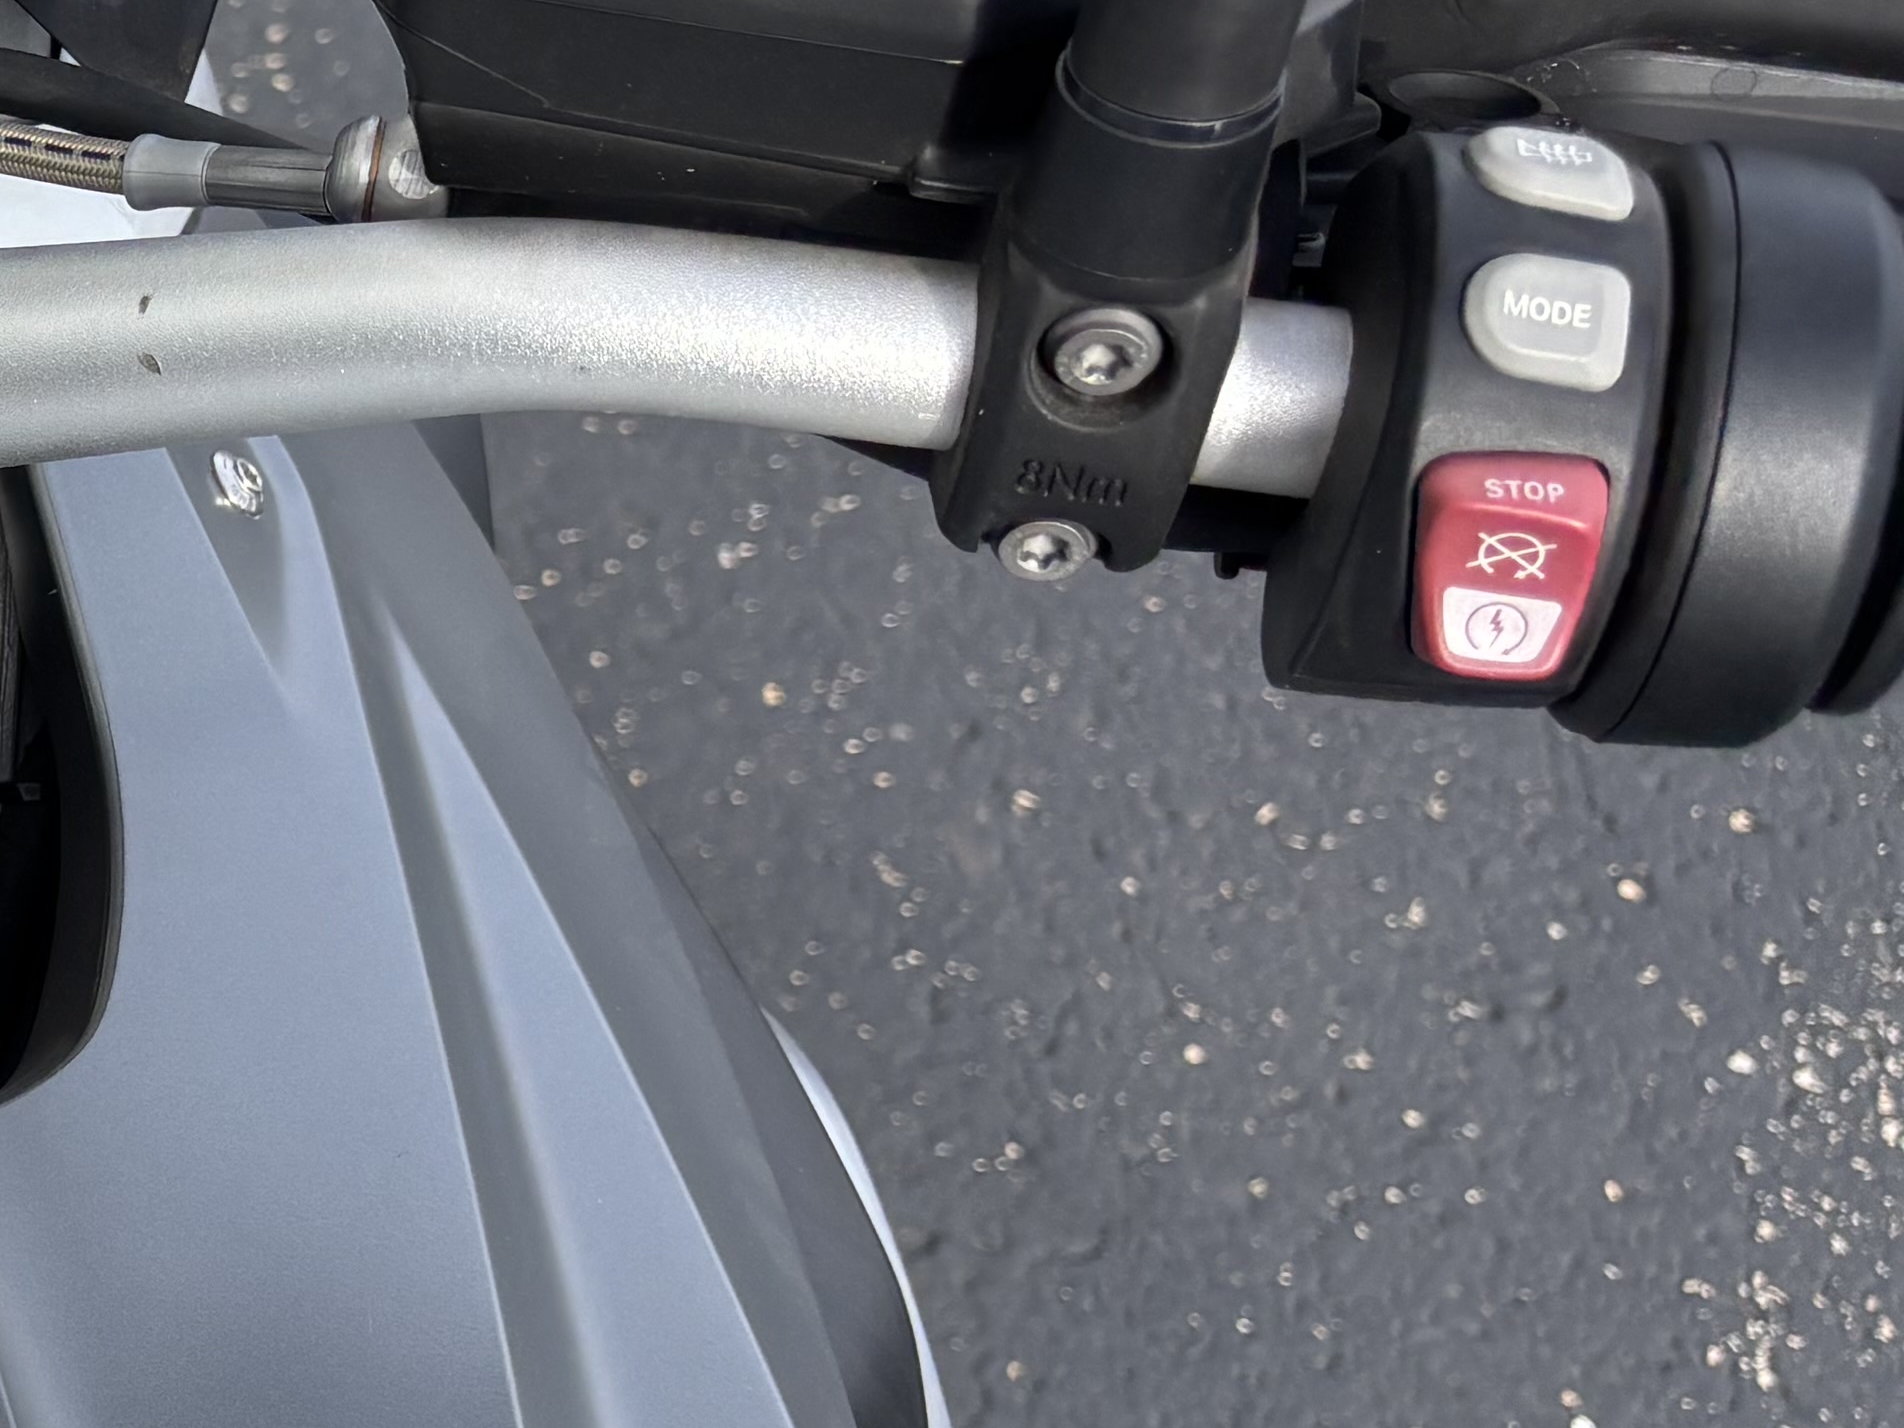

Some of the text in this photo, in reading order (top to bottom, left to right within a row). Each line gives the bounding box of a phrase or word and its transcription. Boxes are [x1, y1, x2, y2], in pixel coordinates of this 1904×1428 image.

[1502, 288, 1593, 329] MODE
[1015, 458, 1129, 508] 8Nm
[1483, 477, 1566, 504] STOP
